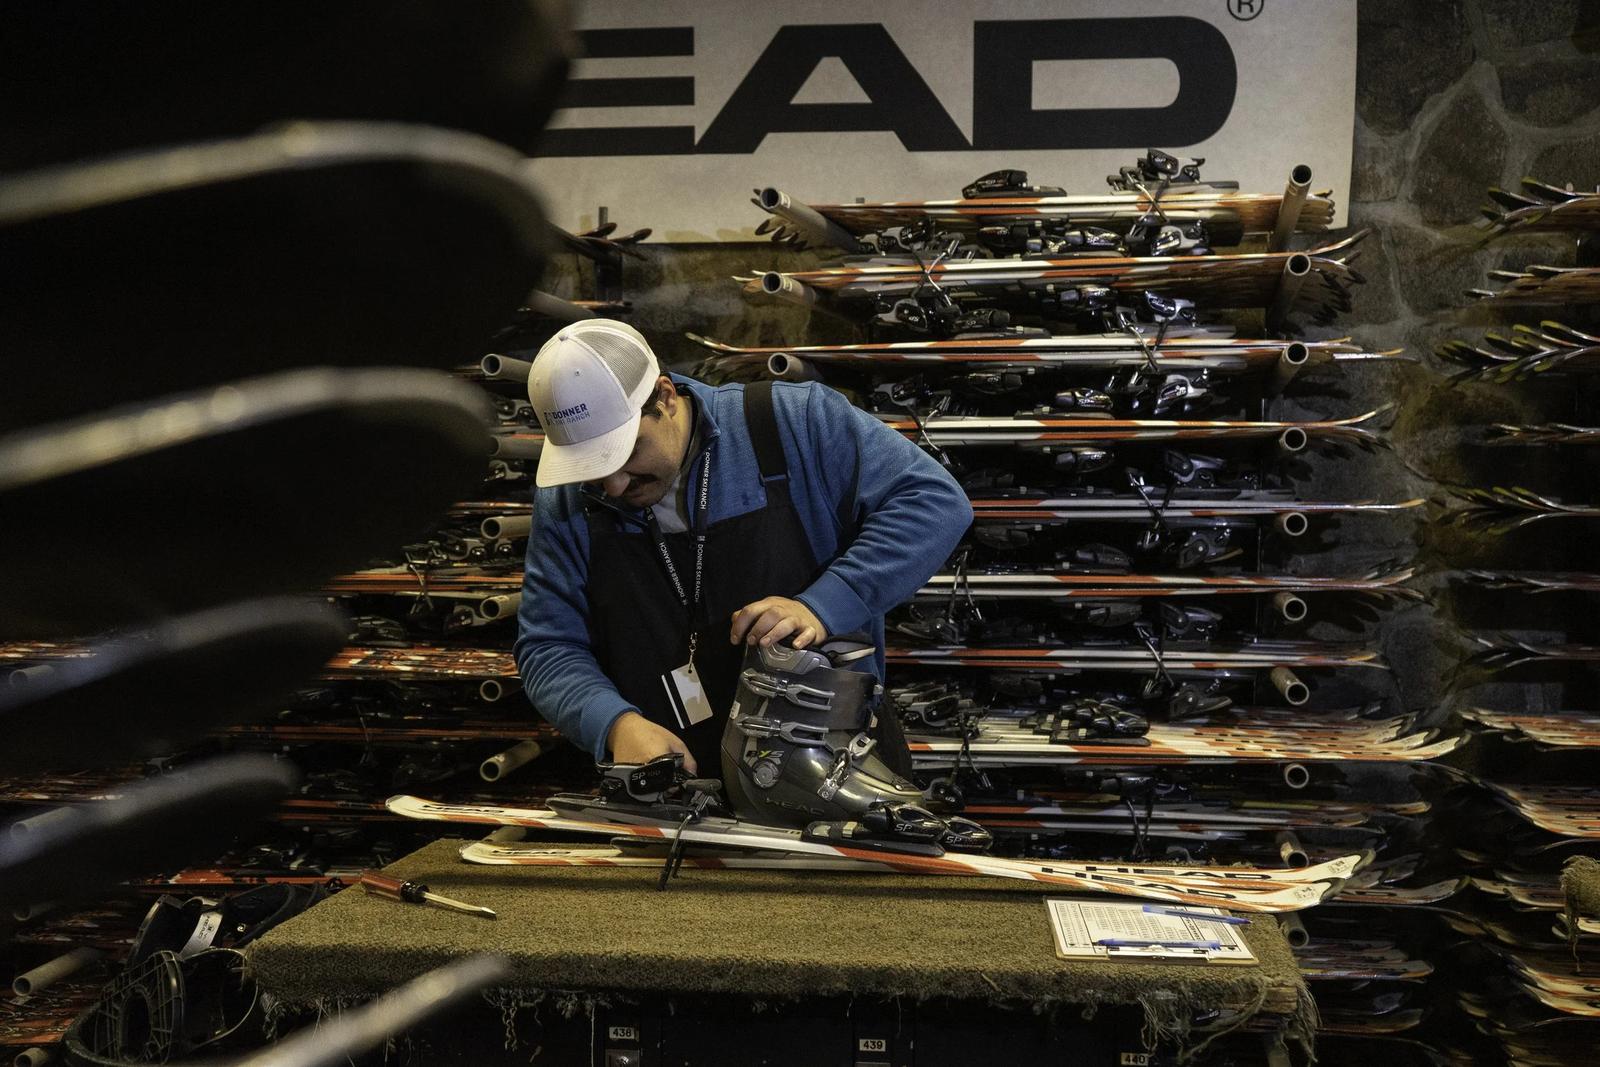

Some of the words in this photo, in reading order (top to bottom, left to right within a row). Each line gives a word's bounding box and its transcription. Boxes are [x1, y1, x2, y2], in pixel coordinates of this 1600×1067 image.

[531, 16, 1238, 155] EAD
[551, 403, 588, 419] DONNER
[700, 488, 708, 510] RANCH
[671, 572, 686, 598] DONNER
[894, 823, 913, 832] SP
[945, 835, 962, 844] SP
[1085, 866, 1272, 880] HEAD
[1041, 867, 1237, 899] HEAD
[612, 1027, 632, 1038] 438
[863, 1040, 883, 1050] 439
[1124, 1054, 1146, 1065] 440
